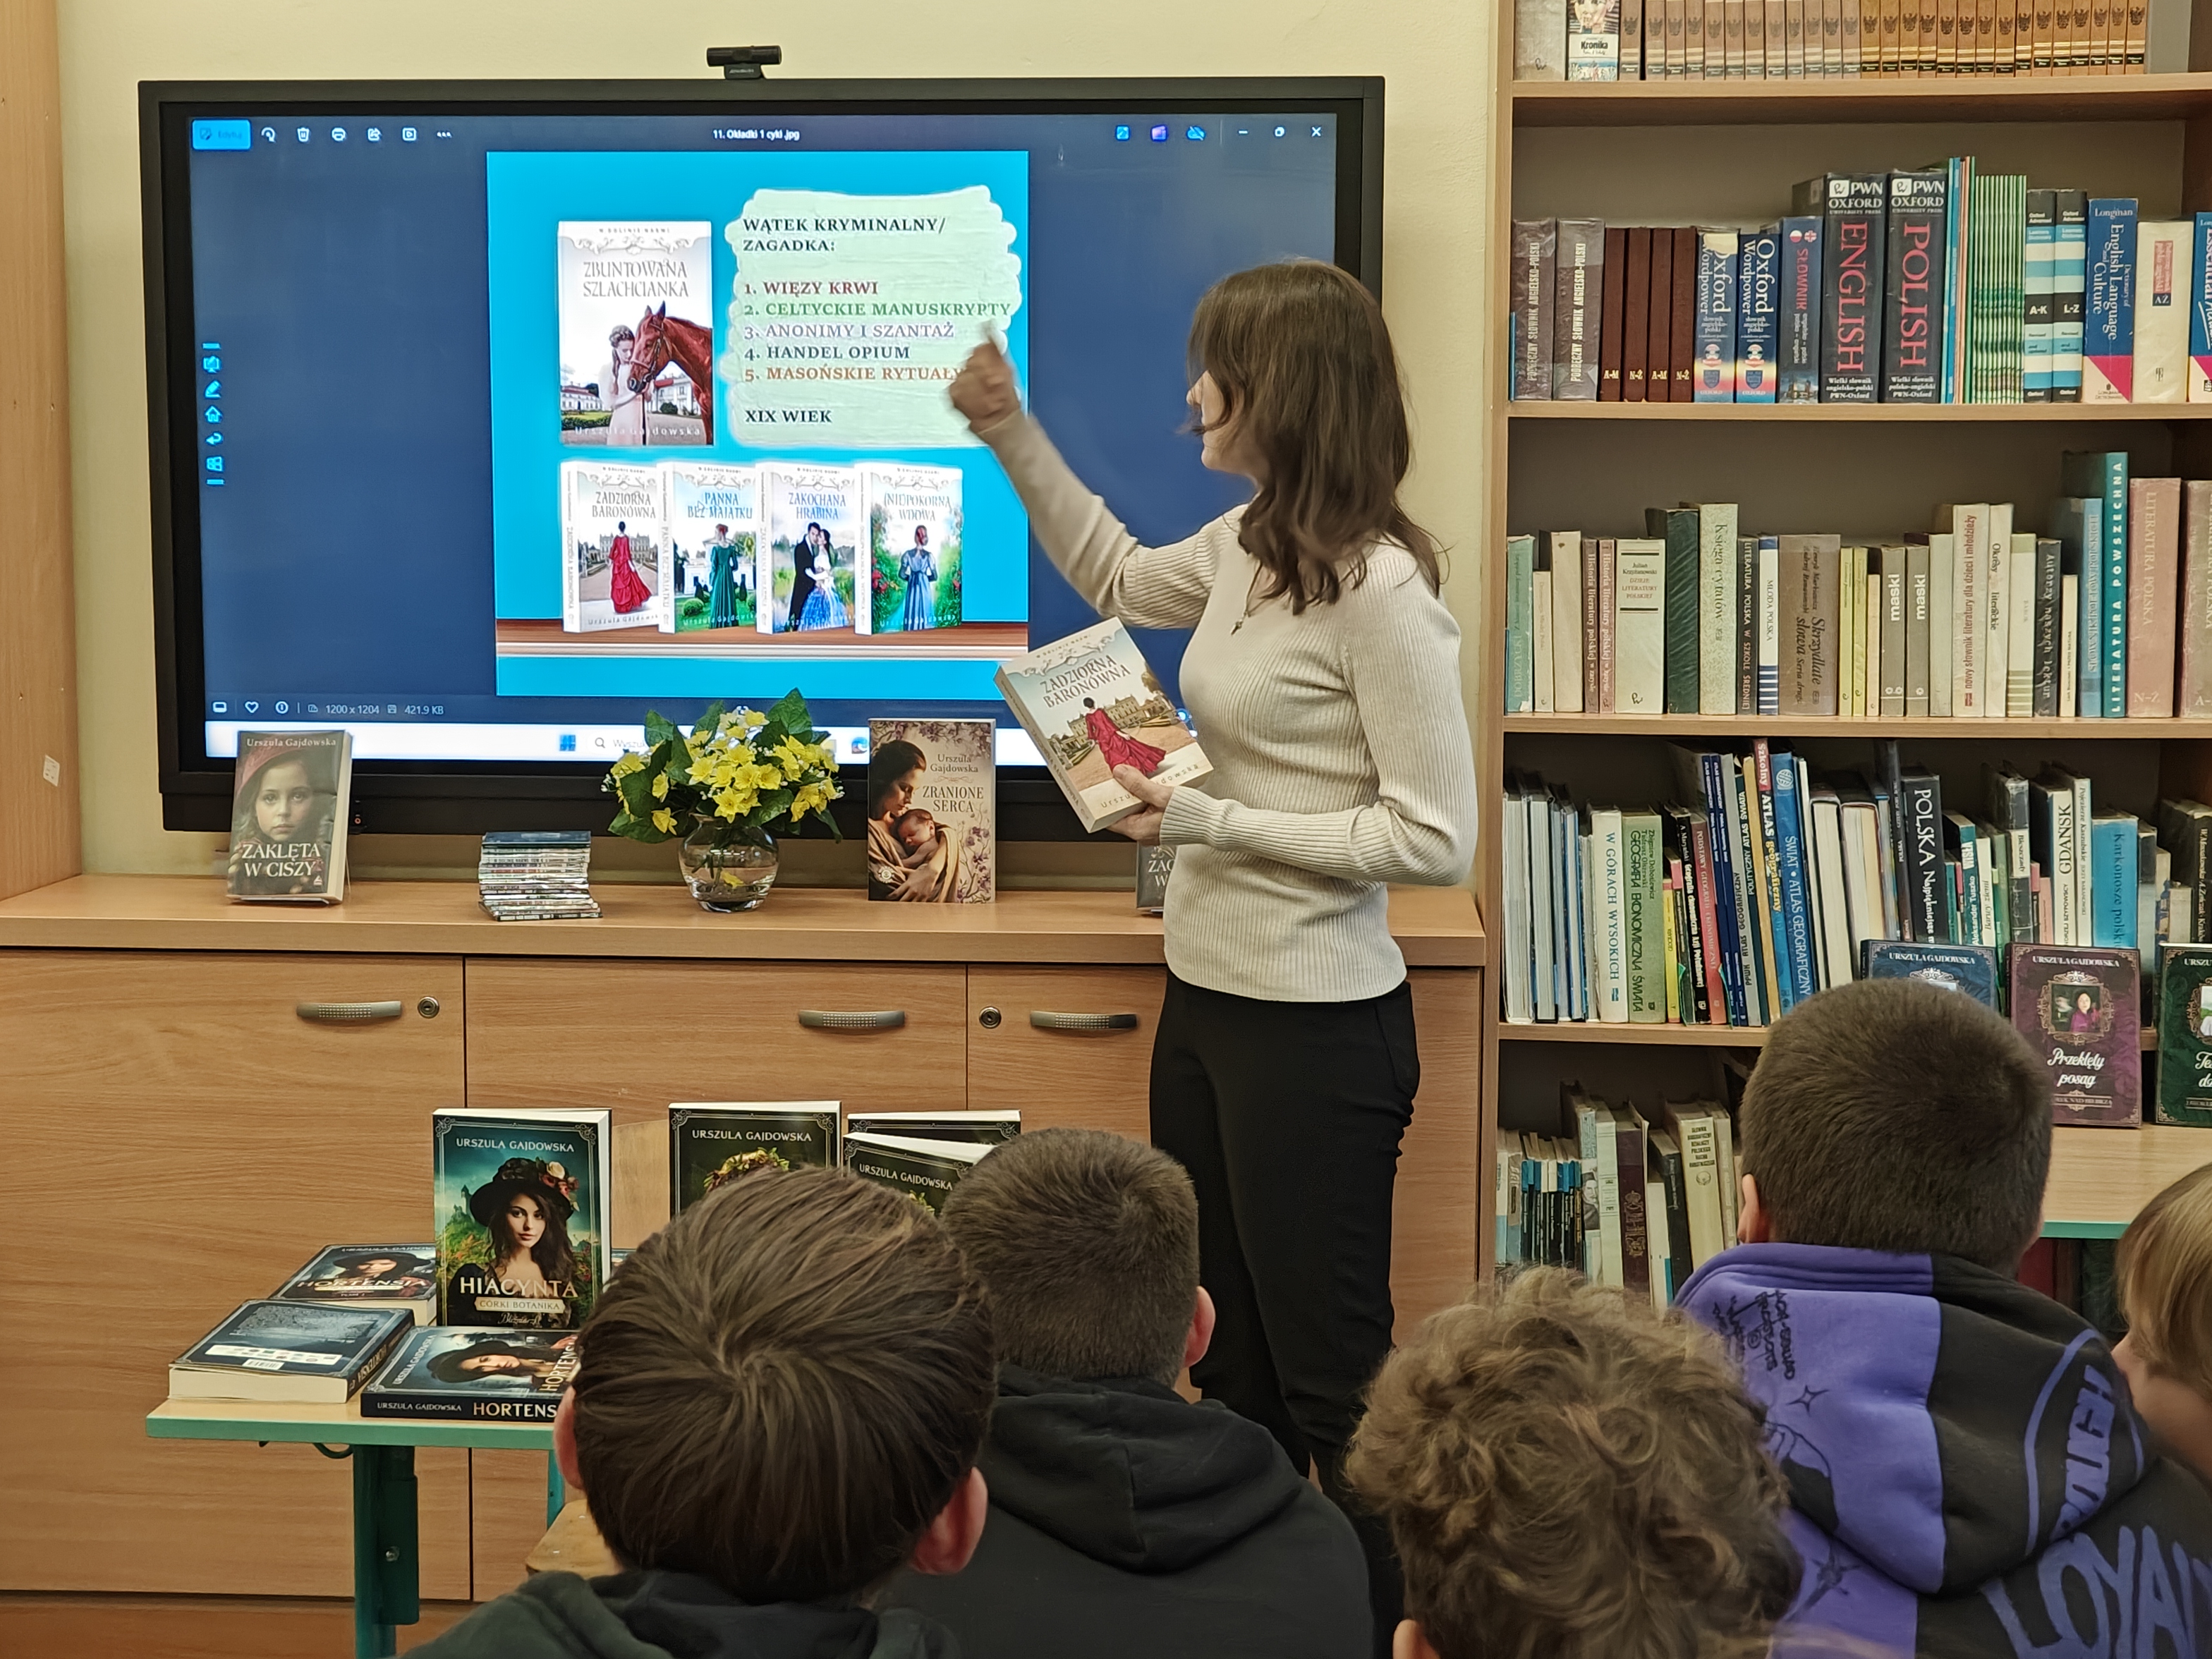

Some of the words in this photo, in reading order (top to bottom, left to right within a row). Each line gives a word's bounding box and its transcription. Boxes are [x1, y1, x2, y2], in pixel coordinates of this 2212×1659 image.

[1581, 41, 1608, 49] Kronika
[1851, 182, 1883, 195] PWN
[1891, 197, 1945, 207] OXFORD
[1914, 181, 1945, 194] PWN
[1829, 198, 1883, 209] OXFORD
[2094, 208, 2133, 219] Longman
[743, 218, 808, 234] WĄTEK
[814, 217, 946, 234] KRYMINALNY/
[743, 239, 836, 252] ZAGADKA:
[2104, 224, 2125, 273] English
[583, 260, 688, 278] ZBUNTOWANA
[1739, 239, 1756, 315] Wordpower
[1756, 238, 1775, 313] Oxford
[1795, 248, 1809, 310] SŁOWNIK
[2123, 264, 2132, 298] Dictionary
[583, 281, 689, 298] SZLACHCIANKA
[744, 283, 757, 295] 1.
[763, 281, 822, 298] WIĘZY
[829, 281, 879, 295] KRWI
[1837, 221, 1868, 372] ENGLISH
[1900, 221, 1931, 367] POLISH
[2092, 262, 2108, 315] Culture
[744, 305, 760, 316] 2.
[765, 303, 866, 316] CELTYCKIE
[872, 303, 1011, 316] MANUSKRYPTY
[2029, 305, 2047, 315] A-K
[2064, 304, 2080, 313] L-Z
[2102, 276, 2122, 341] Language
[744, 325, 760, 339] 3.
[766, 324, 854, 338] ANONIMY
[861, 324, 867, 338] I
[873, 321, 954, 338] SZANTAŻ
[1572, 308, 1584, 340] SŁOWNIK
[744, 347, 760, 361] 4.
[767, 346, 843, 359] HANDEL
[849, 346, 910, 359] OPIUM
[1571, 343, 1583, 382] PODRĘCZNY
[744, 369, 760, 382] 5.
[767, 363, 875, 381] MASOŃSKIE
[745, 410, 777, 423] XIX
[782, 409, 832, 423] WIEK
[591, 504, 657, 518] BARONÓWNA
[596, 492, 652, 506] ZADZIORNA
[705, 492, 740, 505] PANNA
[788, 492, 847, 506] ZAKOCHANA
[796, 506, 839, 521] HRABINA
[898, 509, 936, 521] WDOWA
[2113, 462, 2122, 587] POWSZECHNA
[1714, 524, 1727, 565] Księga
[1965, 515, 1977, 555] młodzieży
[2144, 492, 2157, 571] LITERATURA
[1588, 554, 1596, 586] Historia
[1603, 553, 1612, 586] Historia
[1744, 542, 1752, 590] LITERATURA
[1965, 561, 1974, 583] dzieci
[2043, 554, 2055, 600] Autorzy
[1587, 588, 1597, 626] literatury
[1602, 589, 1612, 626] literatury
[1888, 574, 1900, 621] maski
[1914, 574, 1926, 620] maski
[2143, 576, 2156, 626] POLSKA
[1766, 610, 1774, 642] POLSKA
[1964, 599, 1974, 634] literatury
[1586, 629, 1597, 660] polskiej
[1743, 642, 1751, 670] SZKOLE
[1809, 616, 1825, 685] Skrzydlate
[1964, 636, 1974, 667] słownik
[2112, 600, 2122, 712] LITERATURA
[1040, 655, 1118, 694] ZADZIORNA
[1043, 664, 1131, 708] BARONÓWNA
[1964, 665, 1974, 689] nowy
[1742, 675, 1751, 710] ŚREDNIEJ
[326, 705, 348, 715] 1200
[357, 705, 380, 716] 1204
[404, 705, 430, 716] 421.9
[431, 705, 444, 715] KB
[247, 739, 283, 747] Urszula
[285, 738, 336, 748] Gajdowska
[930, 763, 979, 774] Gajdowska
[937, 754, 972, 763] Urszula
[1757, 743, 1768, 786] Szkolny
[922, 786, 985, 799] ZRANIONE
[932, 800, 975, 813] SERCA
[1737, 791, 1747, 820] ŚWIATA
[1761, 794, 1775, 837] ATLAS
[1914, 789, 1936, 867] POLSKA
[1605, 832, 1616, 845] W
[1697, 830, 1707, 870] PODSTAWY
[1741, 823, 1750, 848] ATLAS
[2058, 803, 2072, 875] GDAŃSK
[242, 843, 321, 862] ZAKLĘTA
[1630, 830, 1641, 888] GEOGRAFIA
[1785, 835, 1799, 868] ŚWIAT
[1961, 841, 1975, 870] WISŁA
[245, 863, 262, 877] W
[267, 861, 317, 877] CISZY
[1605, 848, 1618, 906] GÓRACH
[1744, 849, 1754, 895] POLITYCZNY
[1765, 840, 1782, 913] geograficzny
[2114, 833, 2125, 904] Karkonosze
[1733, 873, 1746, 930] GEOGRAFICZNY
[1789, 880, 1804, 913] ATLAS
[1970, 904, 1980, 945] Aleksander
[1983, 904, 1992, 930] Barwy
[1608, 909, 1620, 980] WYSOKICH
[1631, 893, 1642, 971] EKONOMICZNA
[1740, 935, 1749, 956] ATLAS
[1792, 915, 1811, 996] GEOGRAFICZNY
[1889, 952, 1927, 962] URSZULA
[2032, 955, 2070, 966] URSZULA
[1743, 964, 1752, 986] PPWK
[2047, 1047, 2105, 1071] Przeklęty
[456, 1138, 506, 1149] URSZULA
[509, 1140, 575, 1153] GAJDOWSKA
[692, 1129, 743, 1141] URSZULA
[746, 1131, 813, 1143] GAJDOWSKA
[859, 1163, 898, 1181] URSZULA
[899, 1172, 954, 1192] GAJDOWSKA
[460, 1276, 578, 1298] HIACYNTA
[480, 1299, 509, 1309] CÓRKI
[512, 1301, 560, 1311] BOTANIKA
[473, 1402, 558, 1418] HORTENS
